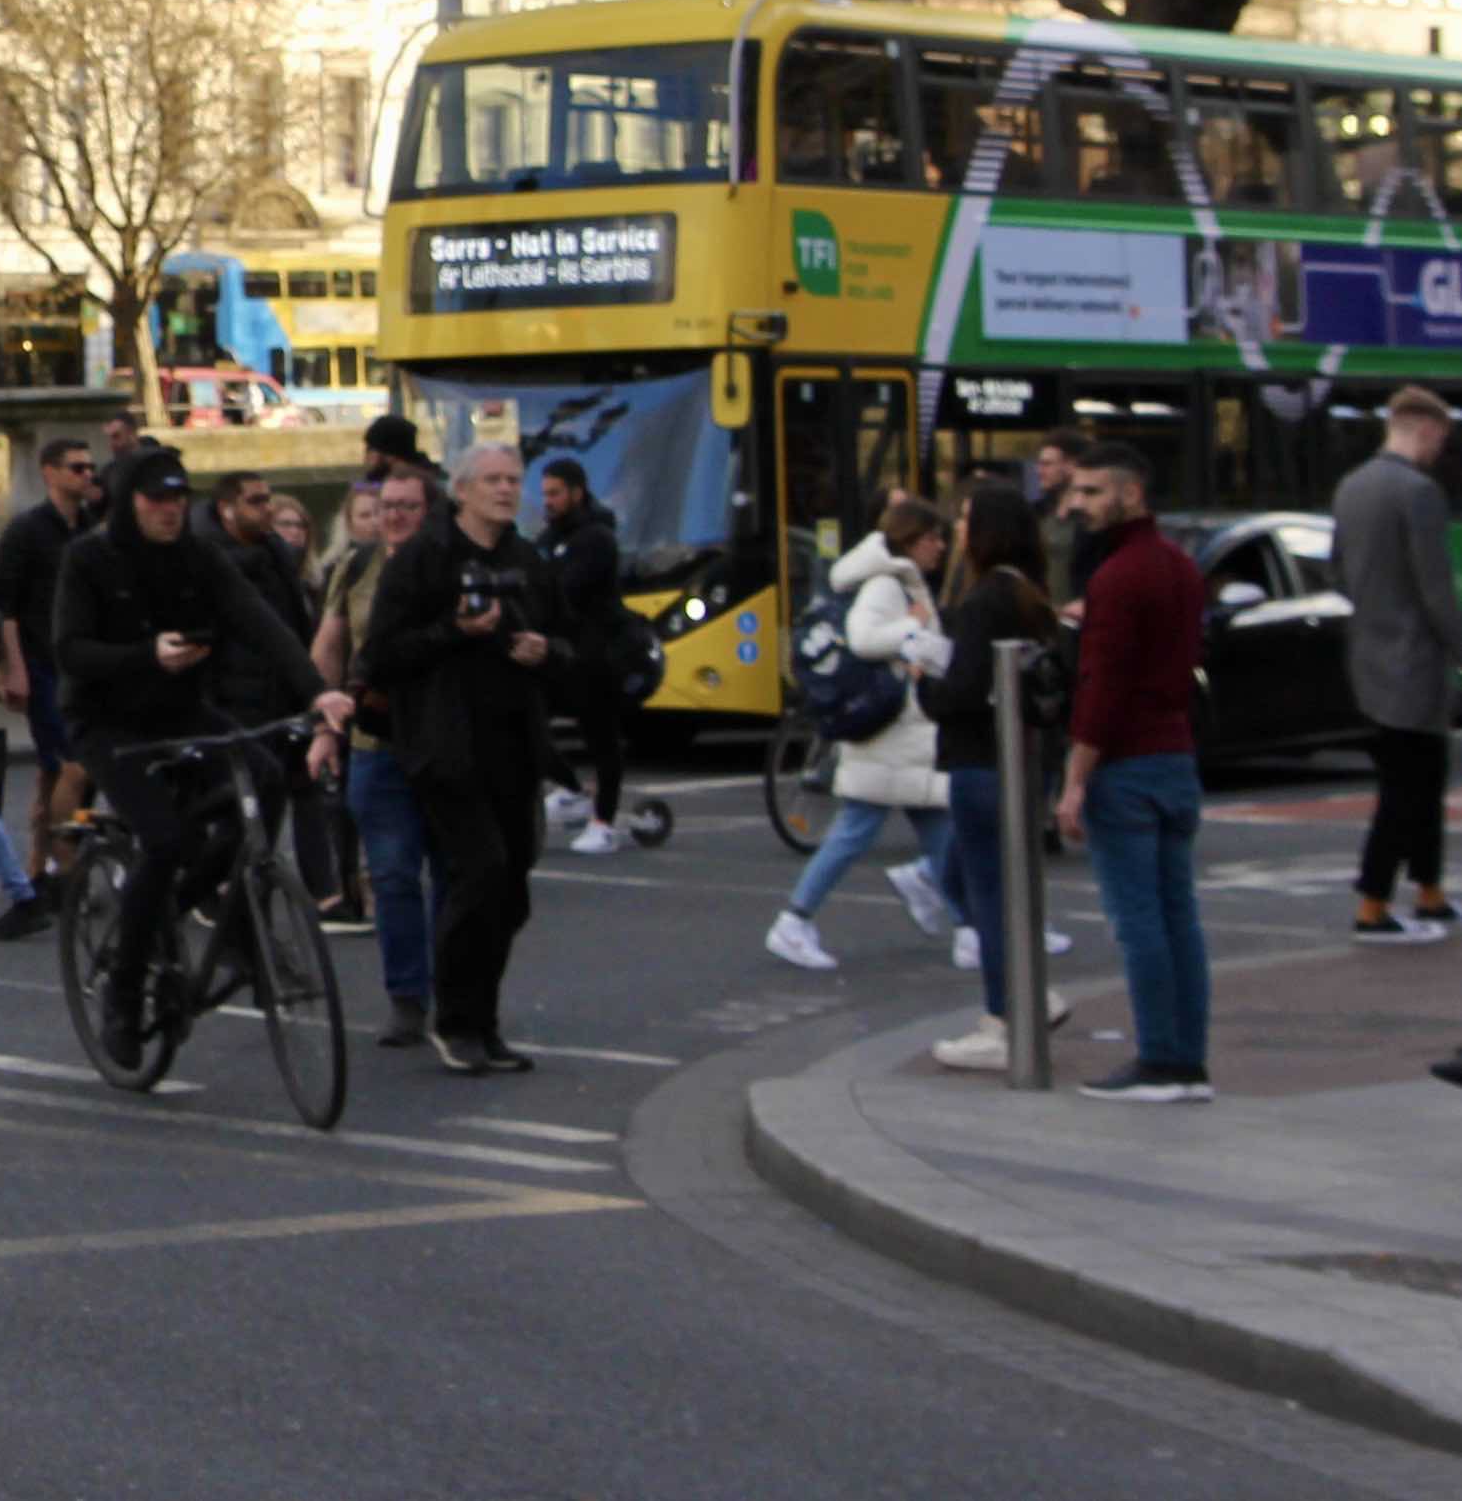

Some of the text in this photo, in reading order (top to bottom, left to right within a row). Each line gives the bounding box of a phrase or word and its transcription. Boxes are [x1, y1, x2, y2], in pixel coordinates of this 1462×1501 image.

[511, 230, 551, 258] Not
[556, 229, 578, 256] in
[582, 227, 660, 254] Service
[797, 237, 837, 271] TFI
